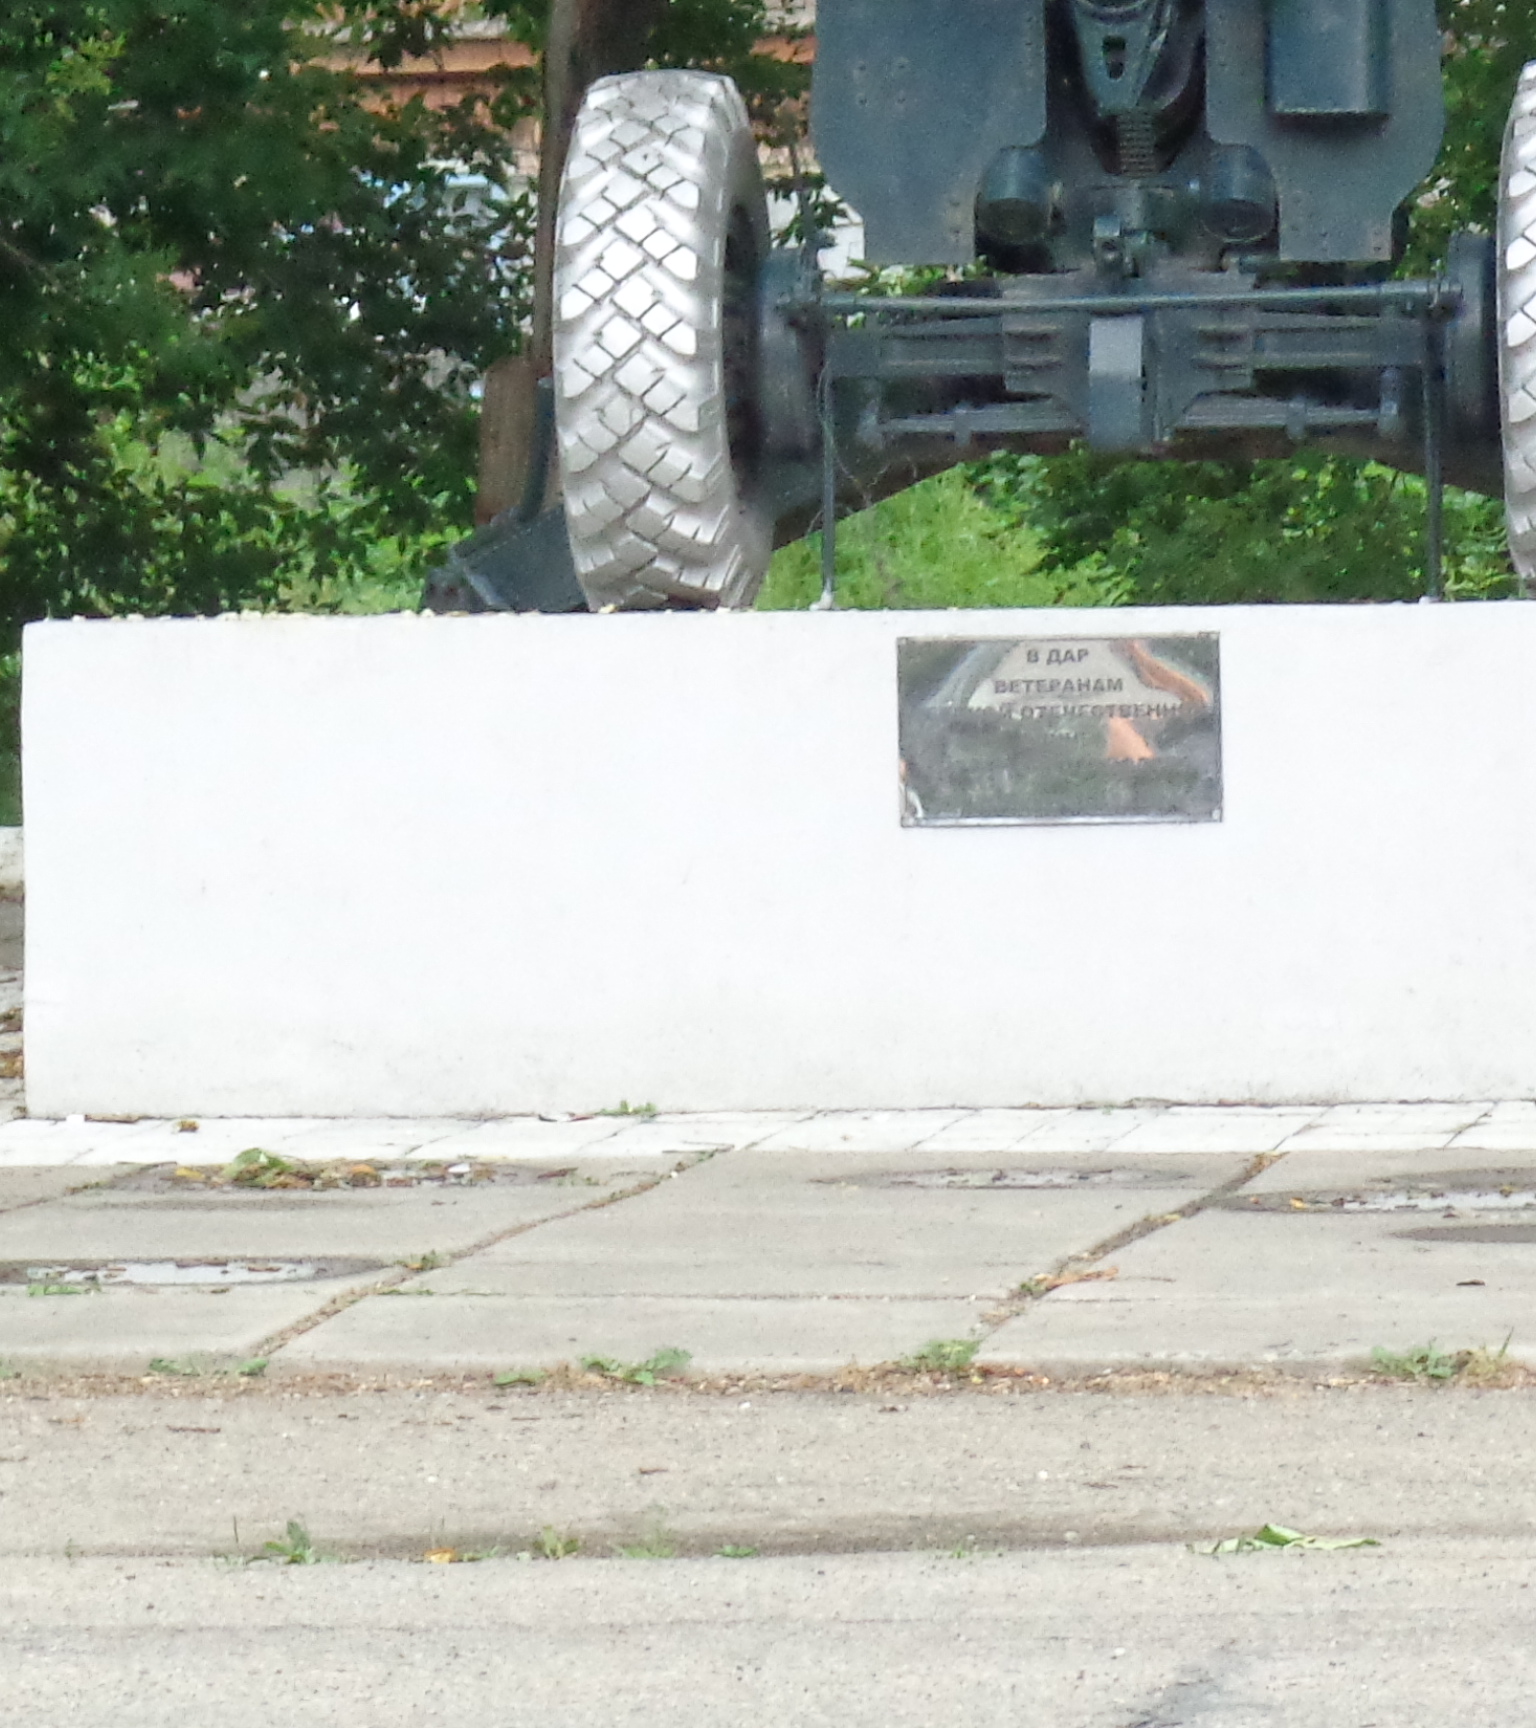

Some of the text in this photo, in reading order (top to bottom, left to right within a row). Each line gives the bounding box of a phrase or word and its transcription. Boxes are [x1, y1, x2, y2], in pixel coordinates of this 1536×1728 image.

[1026, 647, 1090, 666] В ДАР
[994, 677, 1124, 695] ВЕТЕРАНАМ
